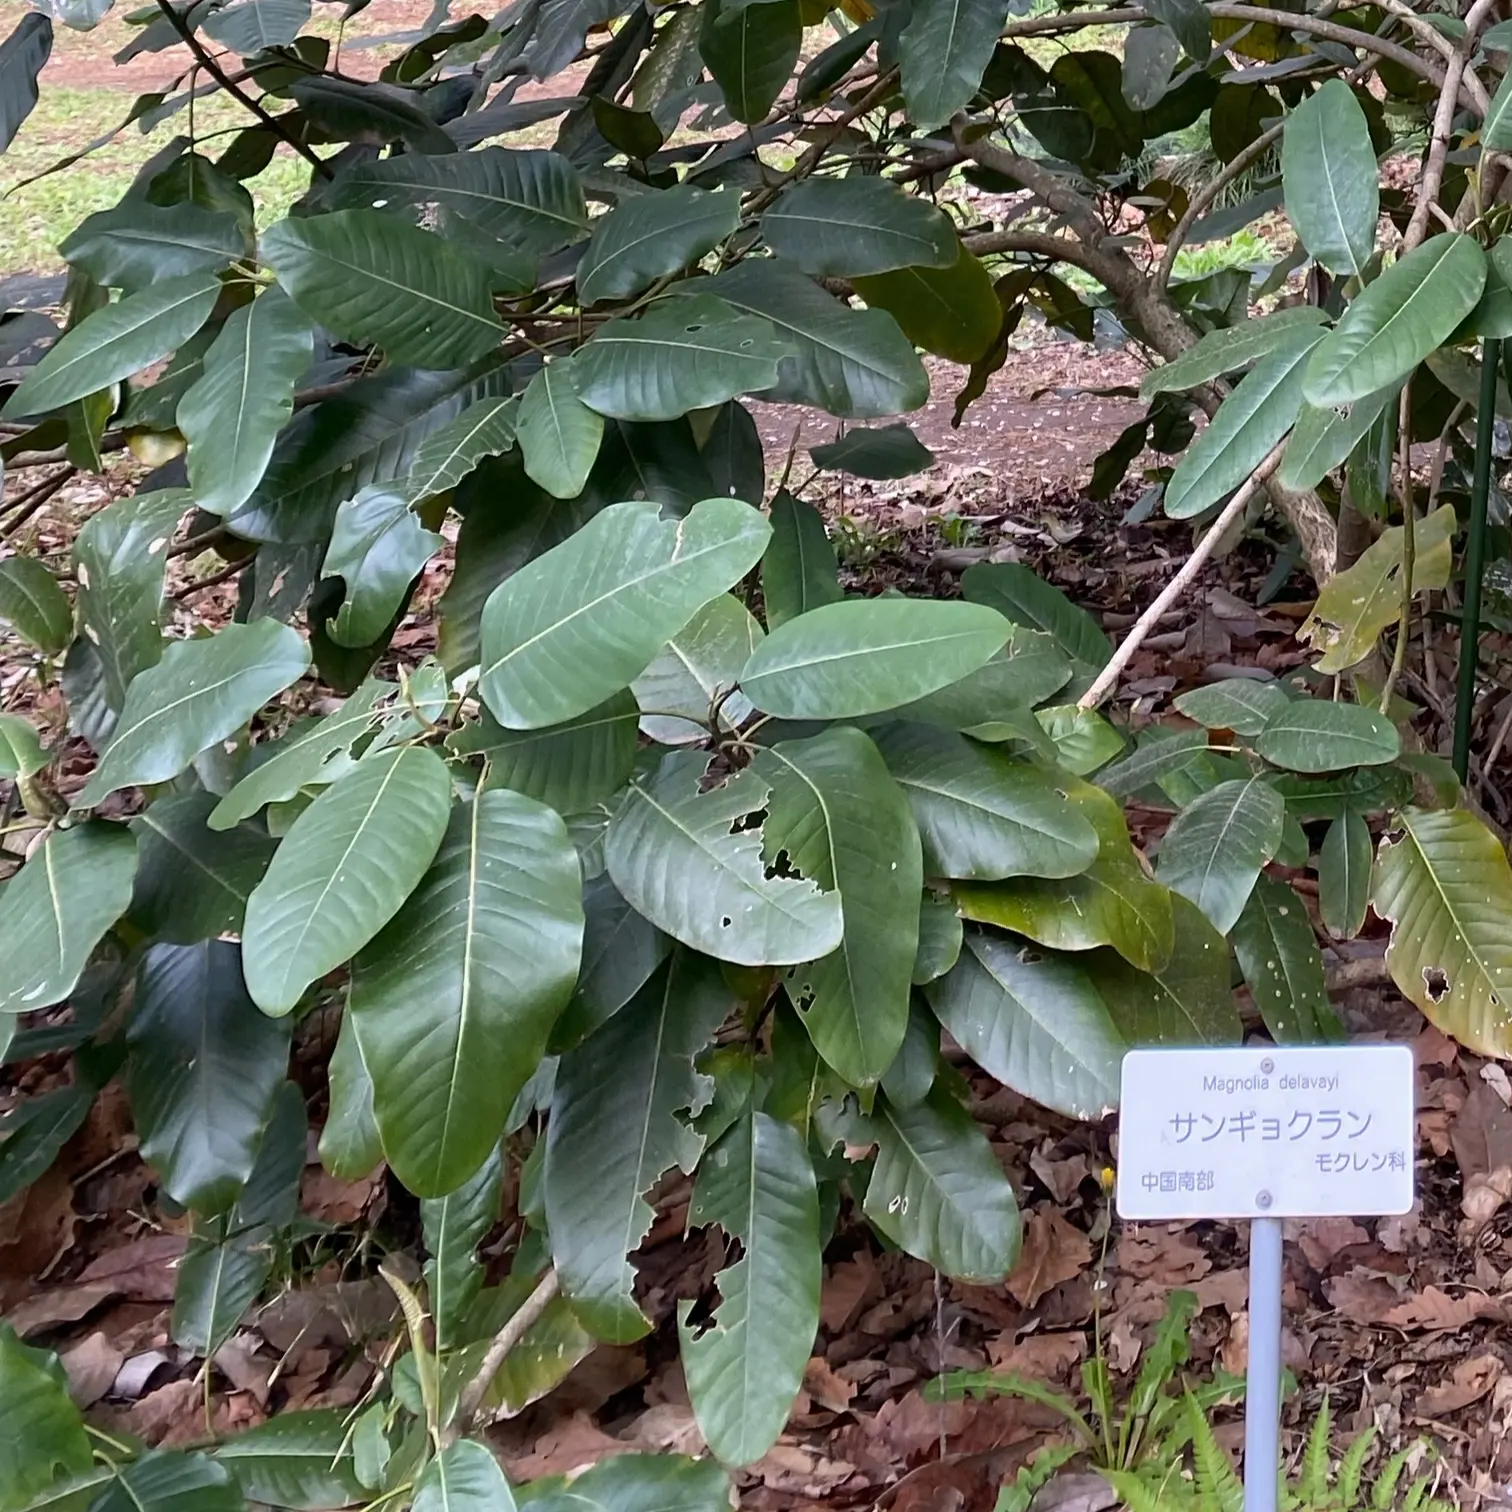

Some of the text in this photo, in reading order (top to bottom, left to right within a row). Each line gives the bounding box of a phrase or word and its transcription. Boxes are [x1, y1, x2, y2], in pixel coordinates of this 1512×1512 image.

[1203, 1073, 1339, 1094] Magnolia delavayi
[1168, 1109, 1372, 1143] サンギョクラン
[1315, 1151, 1406, 1174] モクレン科
[1141, 1170, 1214, 1192] 中国南部
